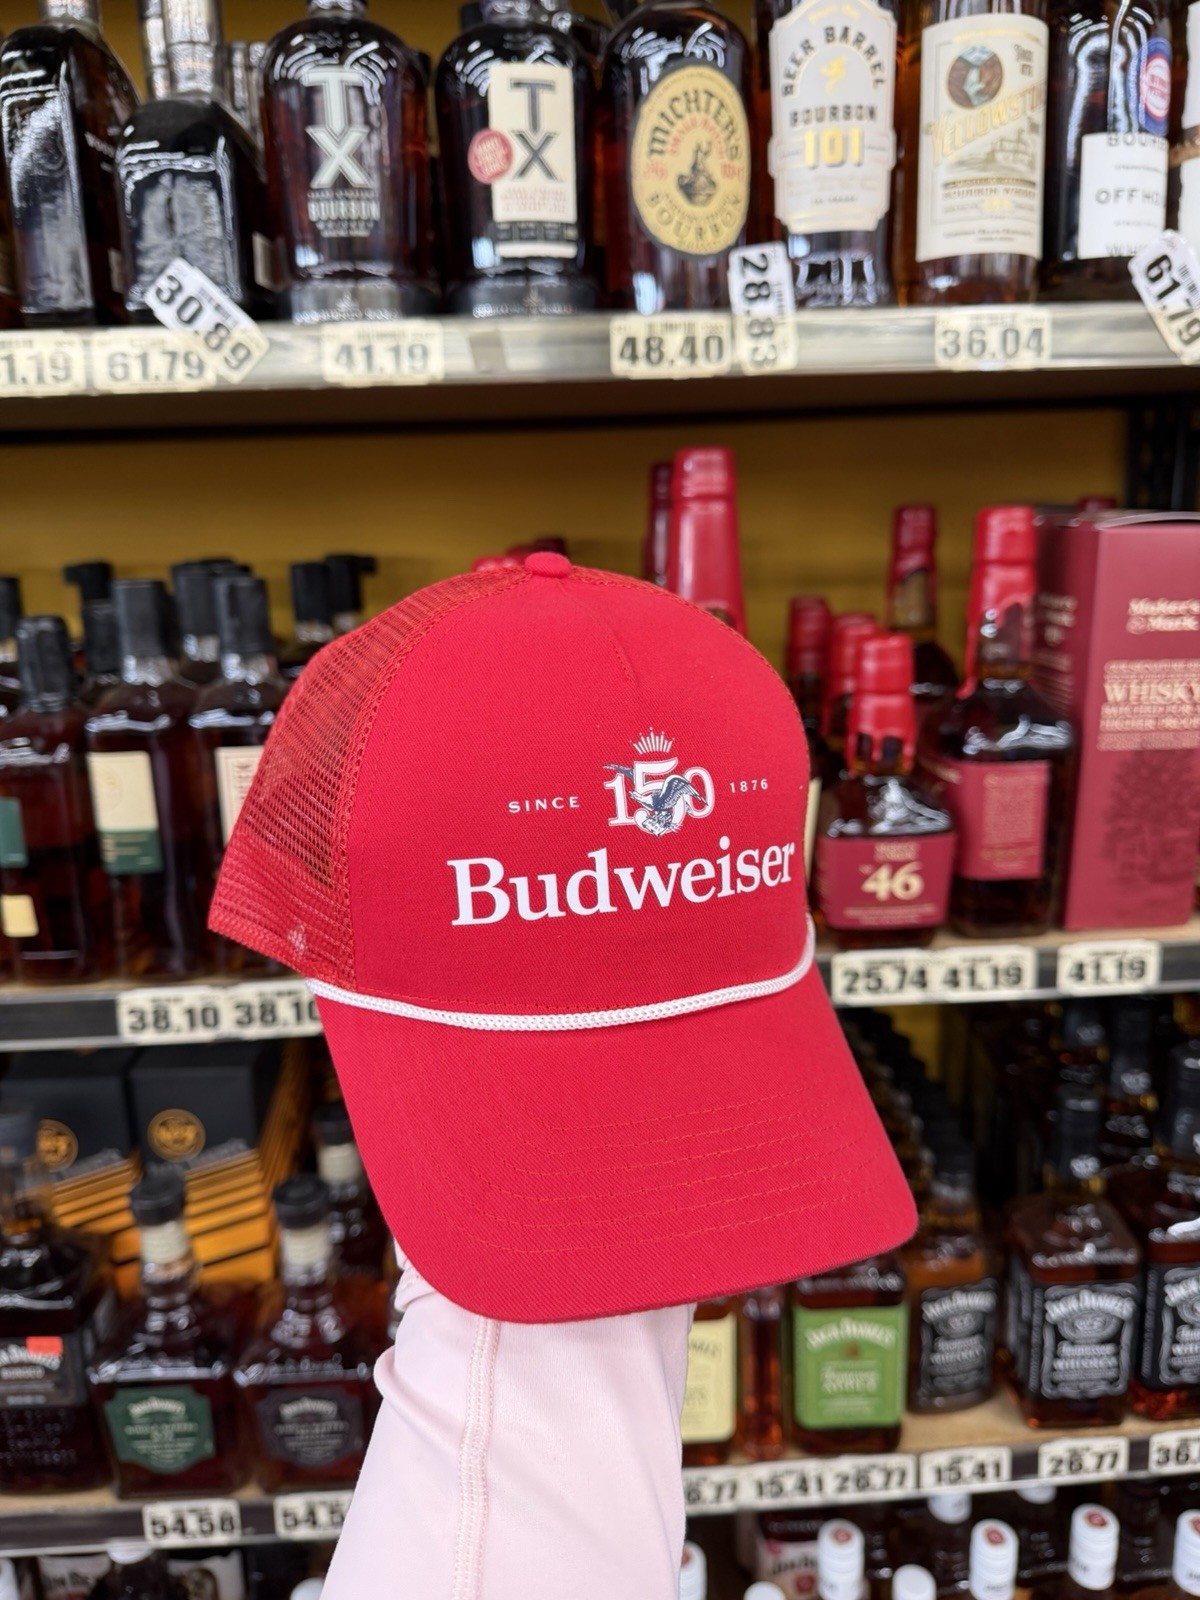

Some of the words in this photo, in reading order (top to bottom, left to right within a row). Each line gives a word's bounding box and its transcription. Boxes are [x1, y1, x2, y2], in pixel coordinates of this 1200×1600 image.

[781, 38, 815, 97] BEER
[823, 25, 886, 91] BARREL
[803, 127, 865, 169] 101
[155, 274, 252, 371] 30.89
[741, 252, 778, 368] 28.83
[334, 343, 430, 374] 41.19
[619, 335, 725, 367] 48.40
[940, 327, 1045, 360] 36.04
[107, 350, 205, 383] 61.79
[508, 795, 580, 814] SINCE
[602, 756, 715, 836] 150
[729, 778, 769, 794] 1876
[446, 835, 795, 926] Budweiser
[861, 861, 925, 902] 46
[843, 965, 927, 994] 25.74
[943, 964, 1023, 991] 41.19
[1069, 959, 1146, 985] 41.19
[129, 1006, 220, 1033] 38.10
[934, 1461, 1001, 1485] 15.41
[1050, 1450, 1119, 1475] 26.77
[753, 1475, 823, 1497] 15.41
[835, 1468, 907, 1492] 26.77
[150, 1513, 235, 1540] 54.58
